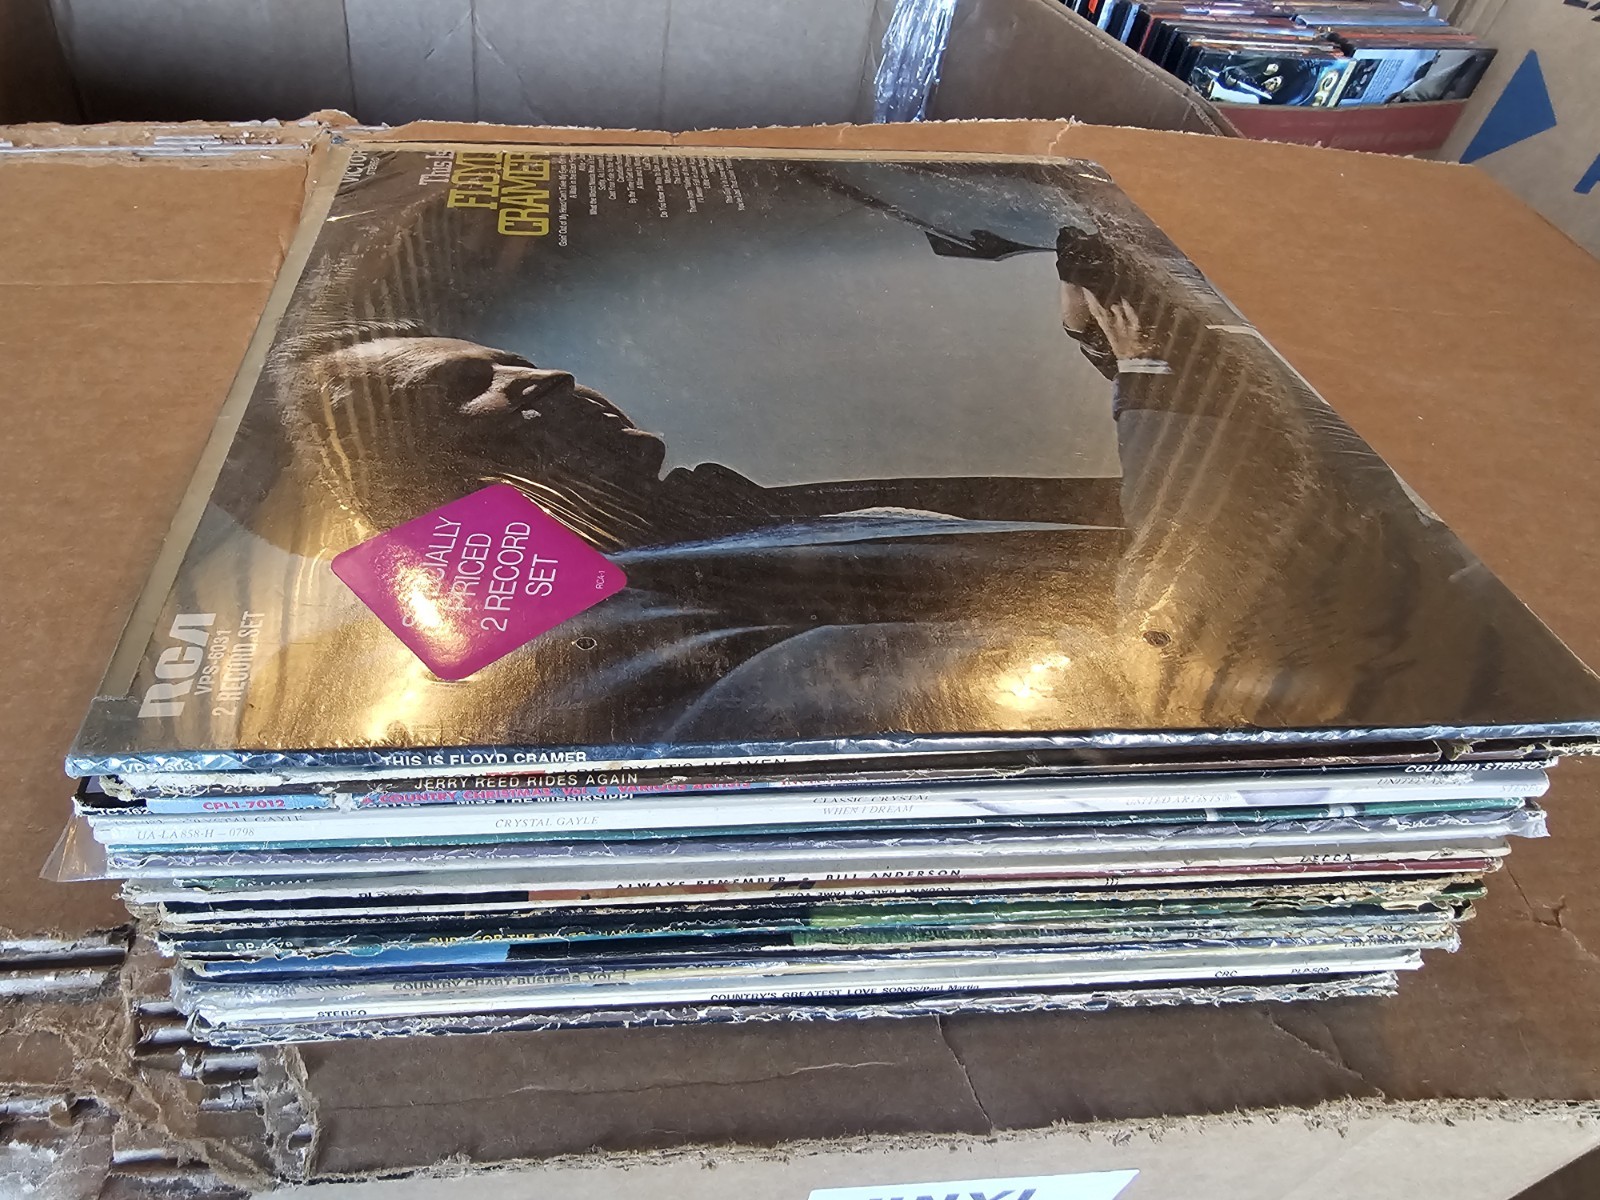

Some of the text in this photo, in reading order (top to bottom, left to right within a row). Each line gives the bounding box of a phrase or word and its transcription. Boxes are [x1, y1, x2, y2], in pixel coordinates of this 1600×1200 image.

[419, 161, 453, 186] This
[446, 152, 503, 210] FLOYD
[497, 151, 550, 236] CRAMER
[480, 522, 532, 632] 2 RECORD
[525, 554, 559, 597] SET
[137, 613, 217, 718] RCA
[194, 629, 231, 696] VPS-6031
[212, 610, 265, 717] 2 RECORD SET
[383, 751, 587, 766] THIS IS FLOYD CRAMER
[1404, 762, 1536, 774] COLUMBIA STEREO
[414, 773, 638, 790] JERRY REED RIDES AGAIN
[380, 791, 456, 803] COUNTRY
[202, 799, 286, 811] CPL1-7012
[822, 805, 914, 815] WHEN I DREAM
[495, 817, 599, 828] CRYSTAL GAYLE
[229, 828, 255, 837] 0798
[869, 870, 961, 879] ANDERSON
[393, 980, 462, 990] COUNTRY
[710, 992, 777, 1001] COUNTRY'S
[782, 990, 842, 998] GREATEST
[317, 1009, 367, 1018] STEREO
